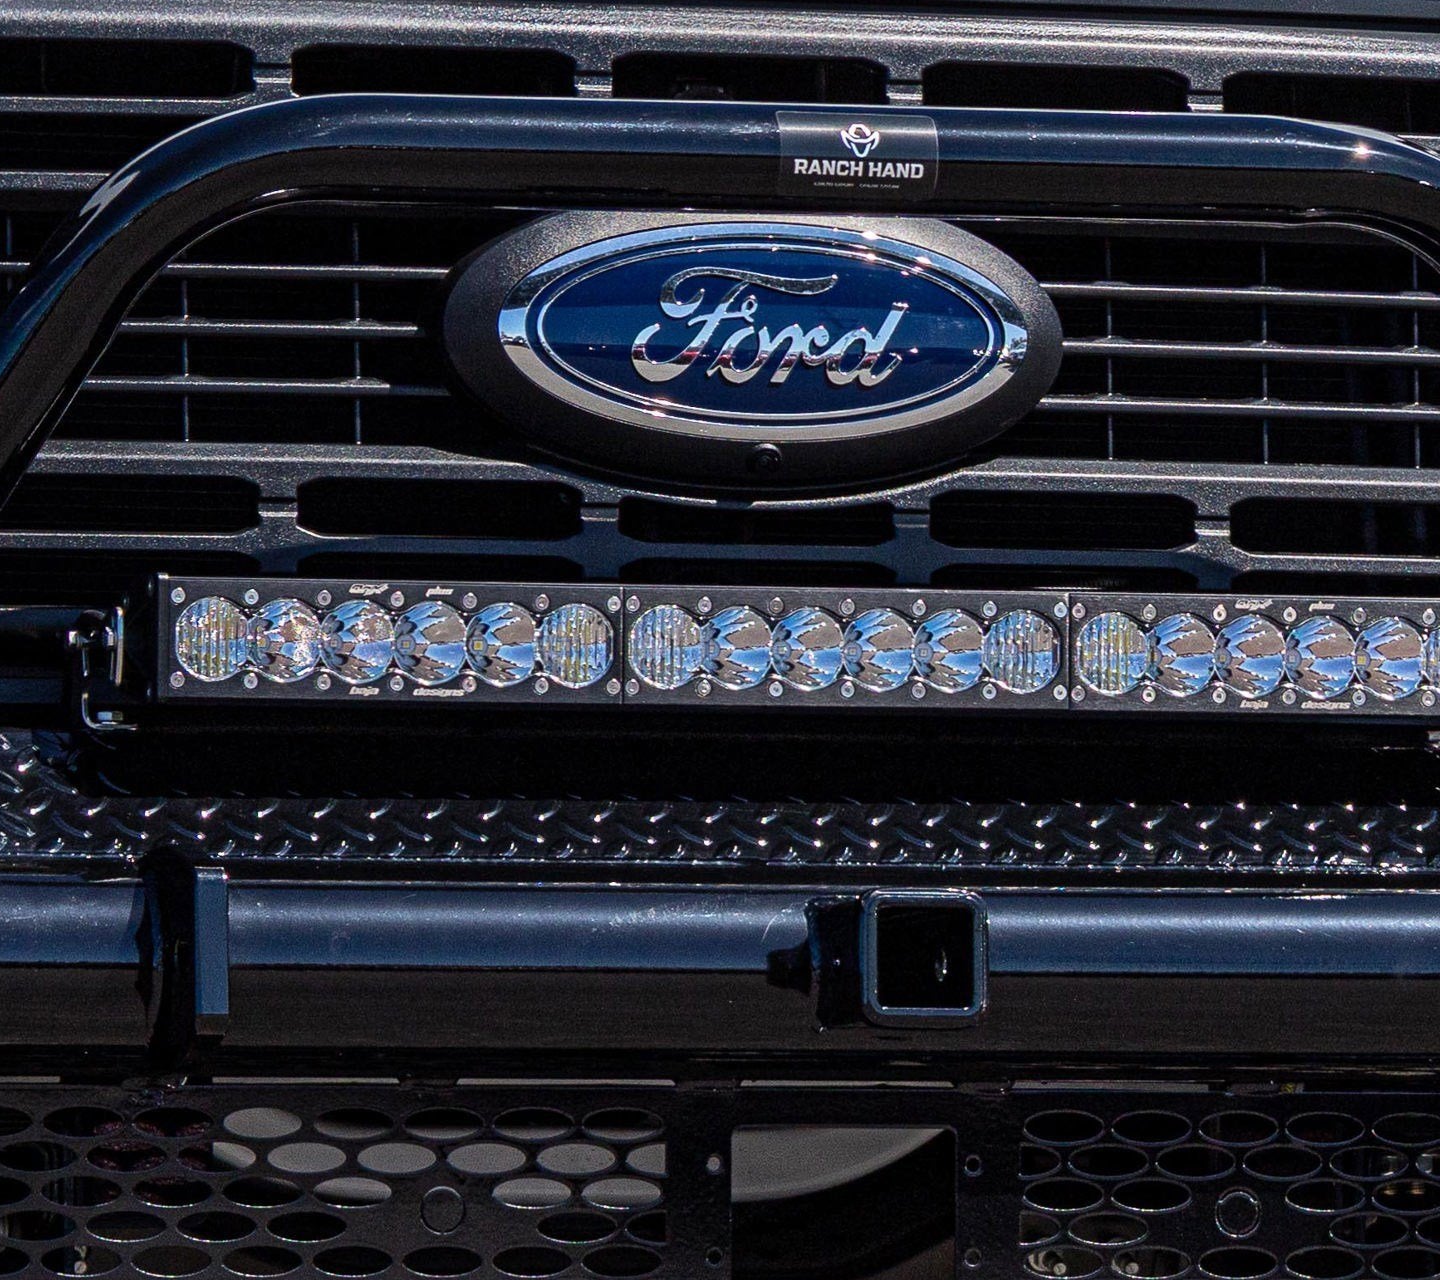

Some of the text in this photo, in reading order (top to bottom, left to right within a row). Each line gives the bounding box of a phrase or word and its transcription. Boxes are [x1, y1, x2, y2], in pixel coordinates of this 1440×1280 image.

[793, 157, 925, 180] RANCH HAND
[630, 266, 910, 387] Ford
